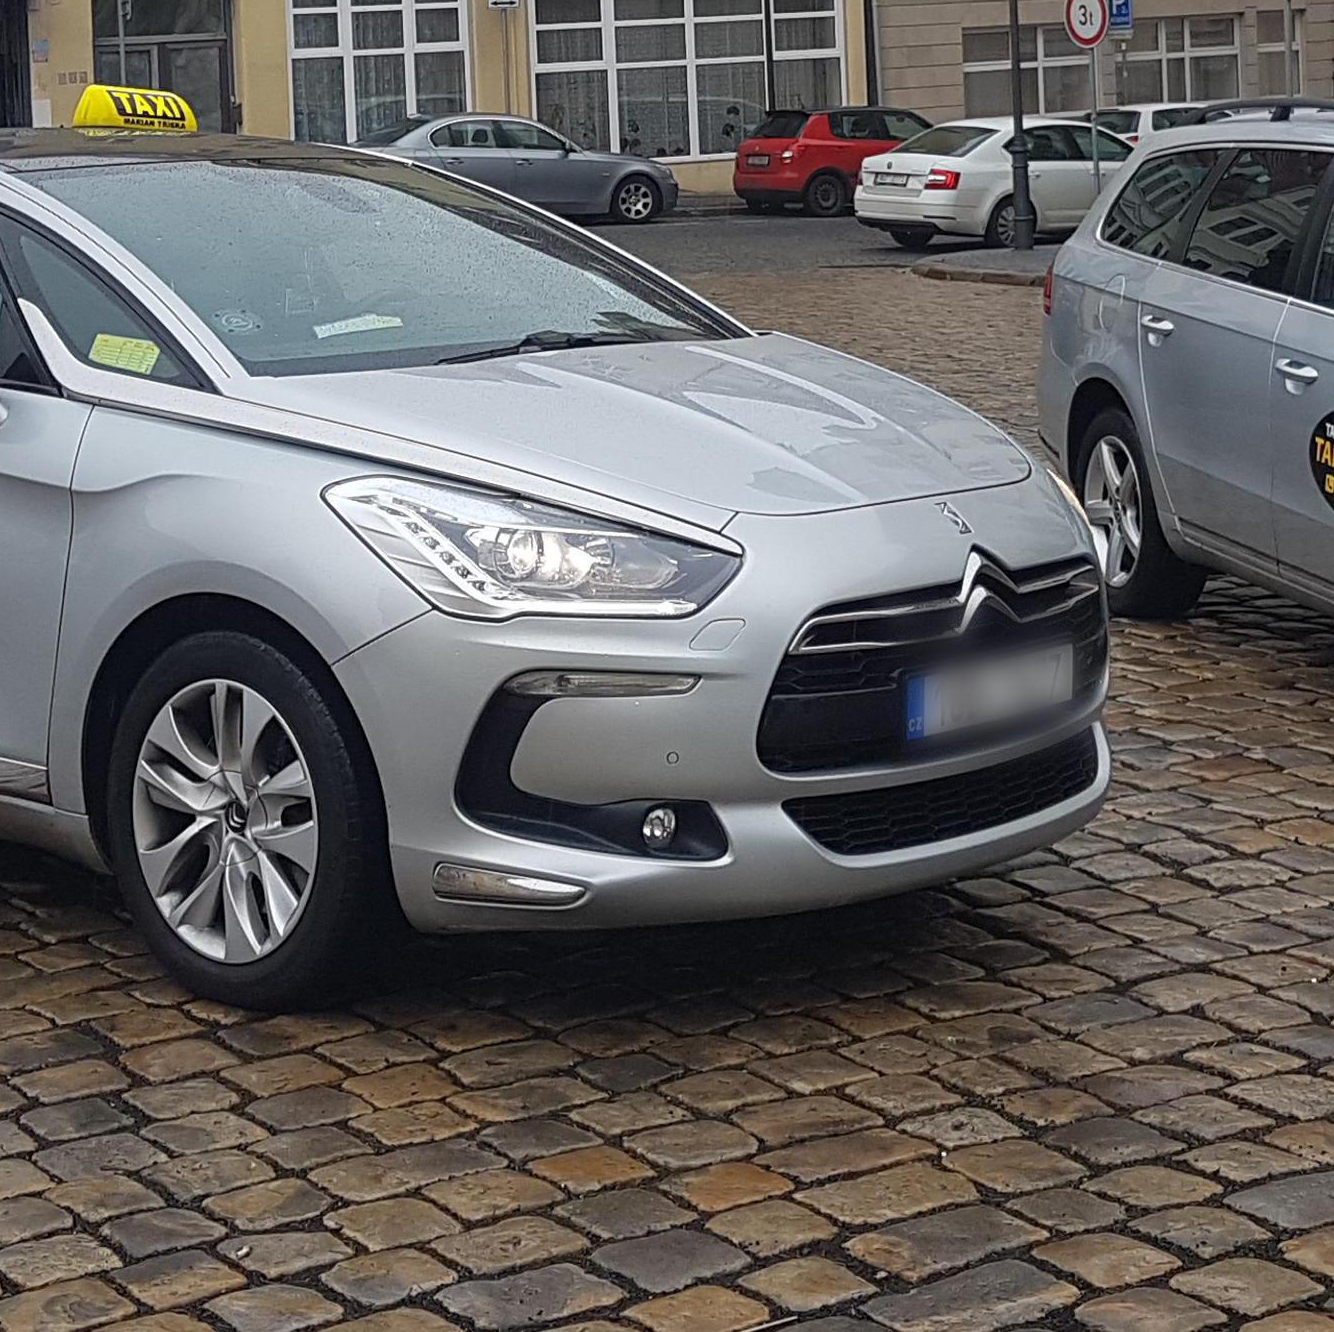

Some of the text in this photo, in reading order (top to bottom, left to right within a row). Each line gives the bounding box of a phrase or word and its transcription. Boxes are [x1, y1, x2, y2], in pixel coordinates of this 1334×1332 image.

[111, 91, 182, 118] TAXI
[123, 118, 155, 127] MARIAN
[908, 717, 923, 731] CZ
